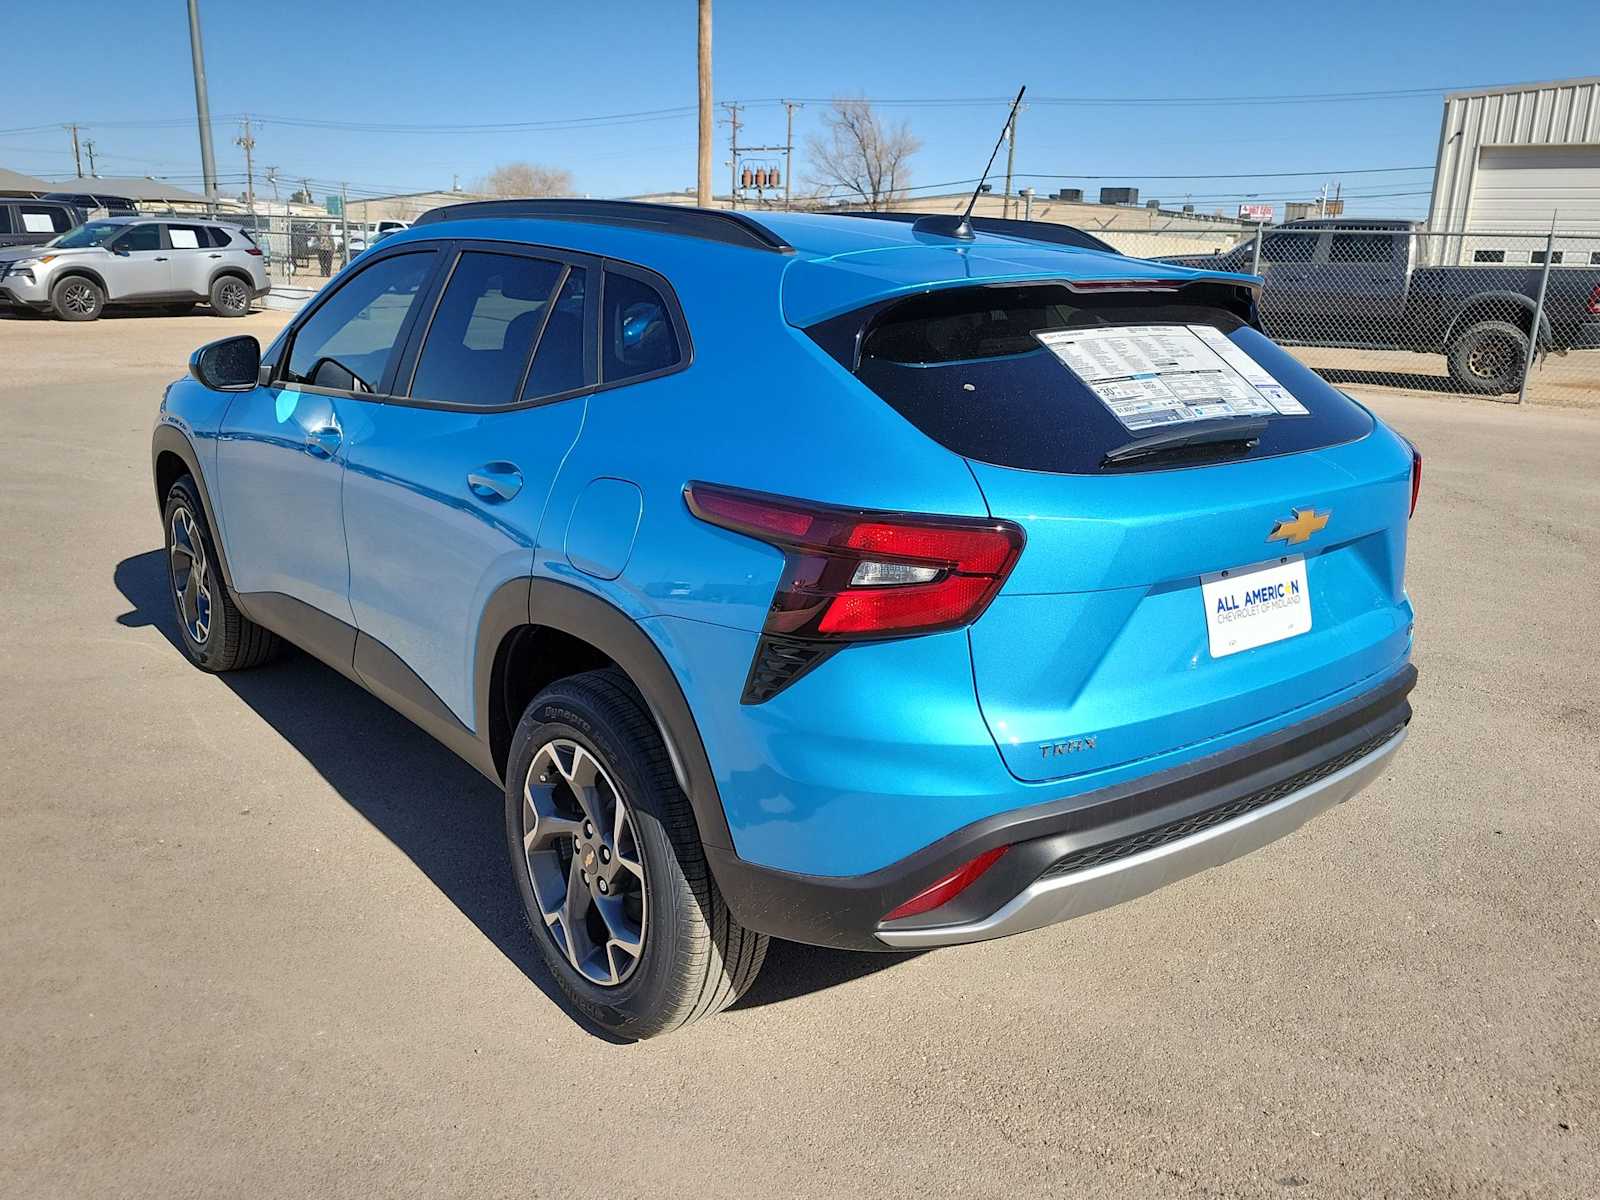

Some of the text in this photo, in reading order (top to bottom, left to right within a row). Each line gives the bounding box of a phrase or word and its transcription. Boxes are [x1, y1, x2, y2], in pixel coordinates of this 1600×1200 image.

[1217, 596, 1239, 613] ALL
[1217, 594, 1301, 625] CHEVROLET OF MIDLAND
[544, 706, 592, 732] Dynapro
[1038, 735, 1097, 760] TRAX
